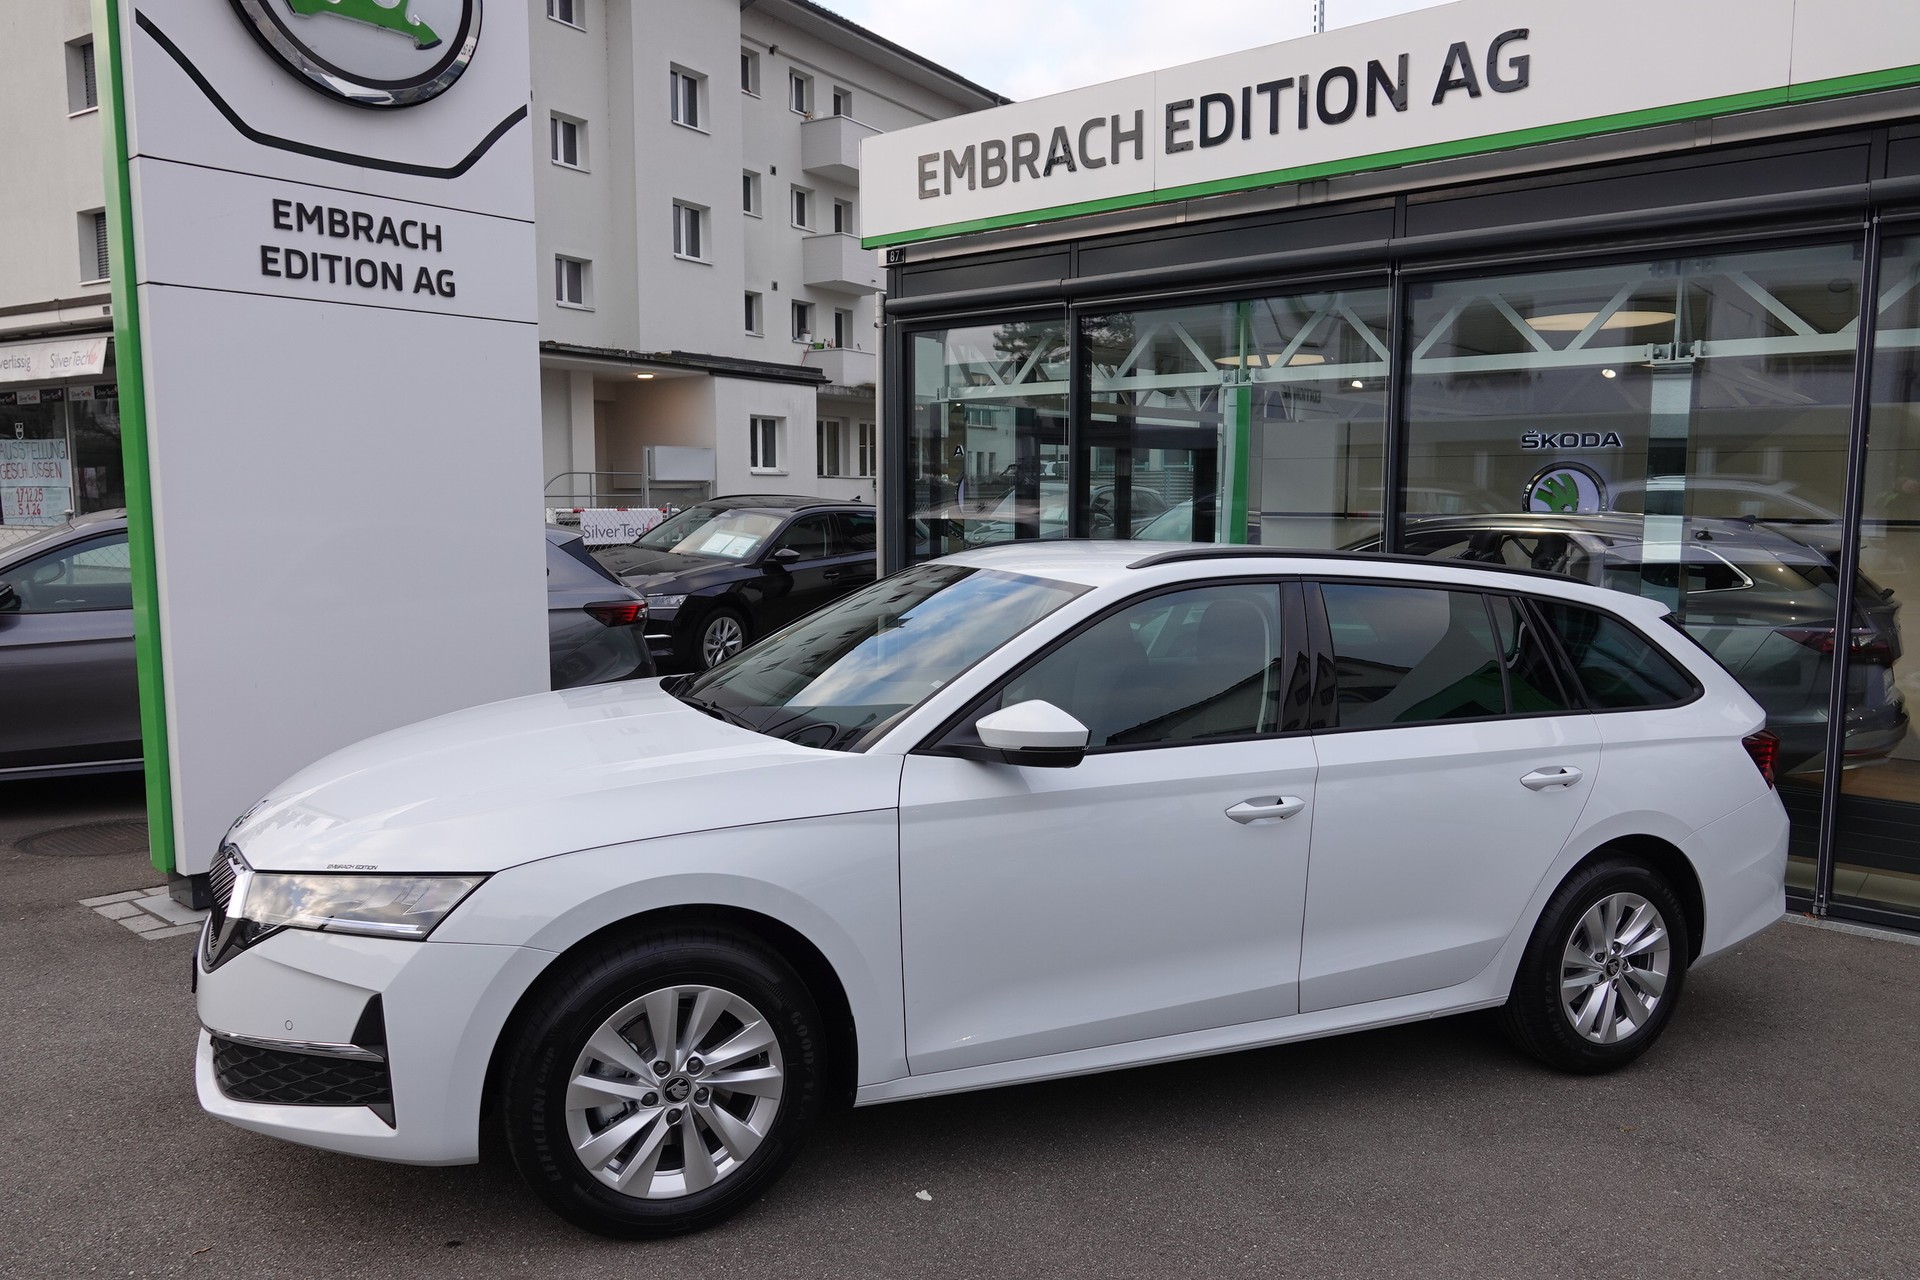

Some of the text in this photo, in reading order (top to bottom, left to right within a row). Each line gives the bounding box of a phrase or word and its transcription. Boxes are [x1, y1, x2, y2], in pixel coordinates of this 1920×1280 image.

[918, 27, 1531, 200] EMBRACH EDITION AG
[272, 198, 443, 252] EMBRACH
[890, 250, 900, 262] 87
[260, 244, 457, 299] EDITION AG
[1520, 429, 1623, 449] ŠKODA
[0, 461, 62, 480] GESCHLOSSEN
[583, 523, 649, 539] SilverTech
